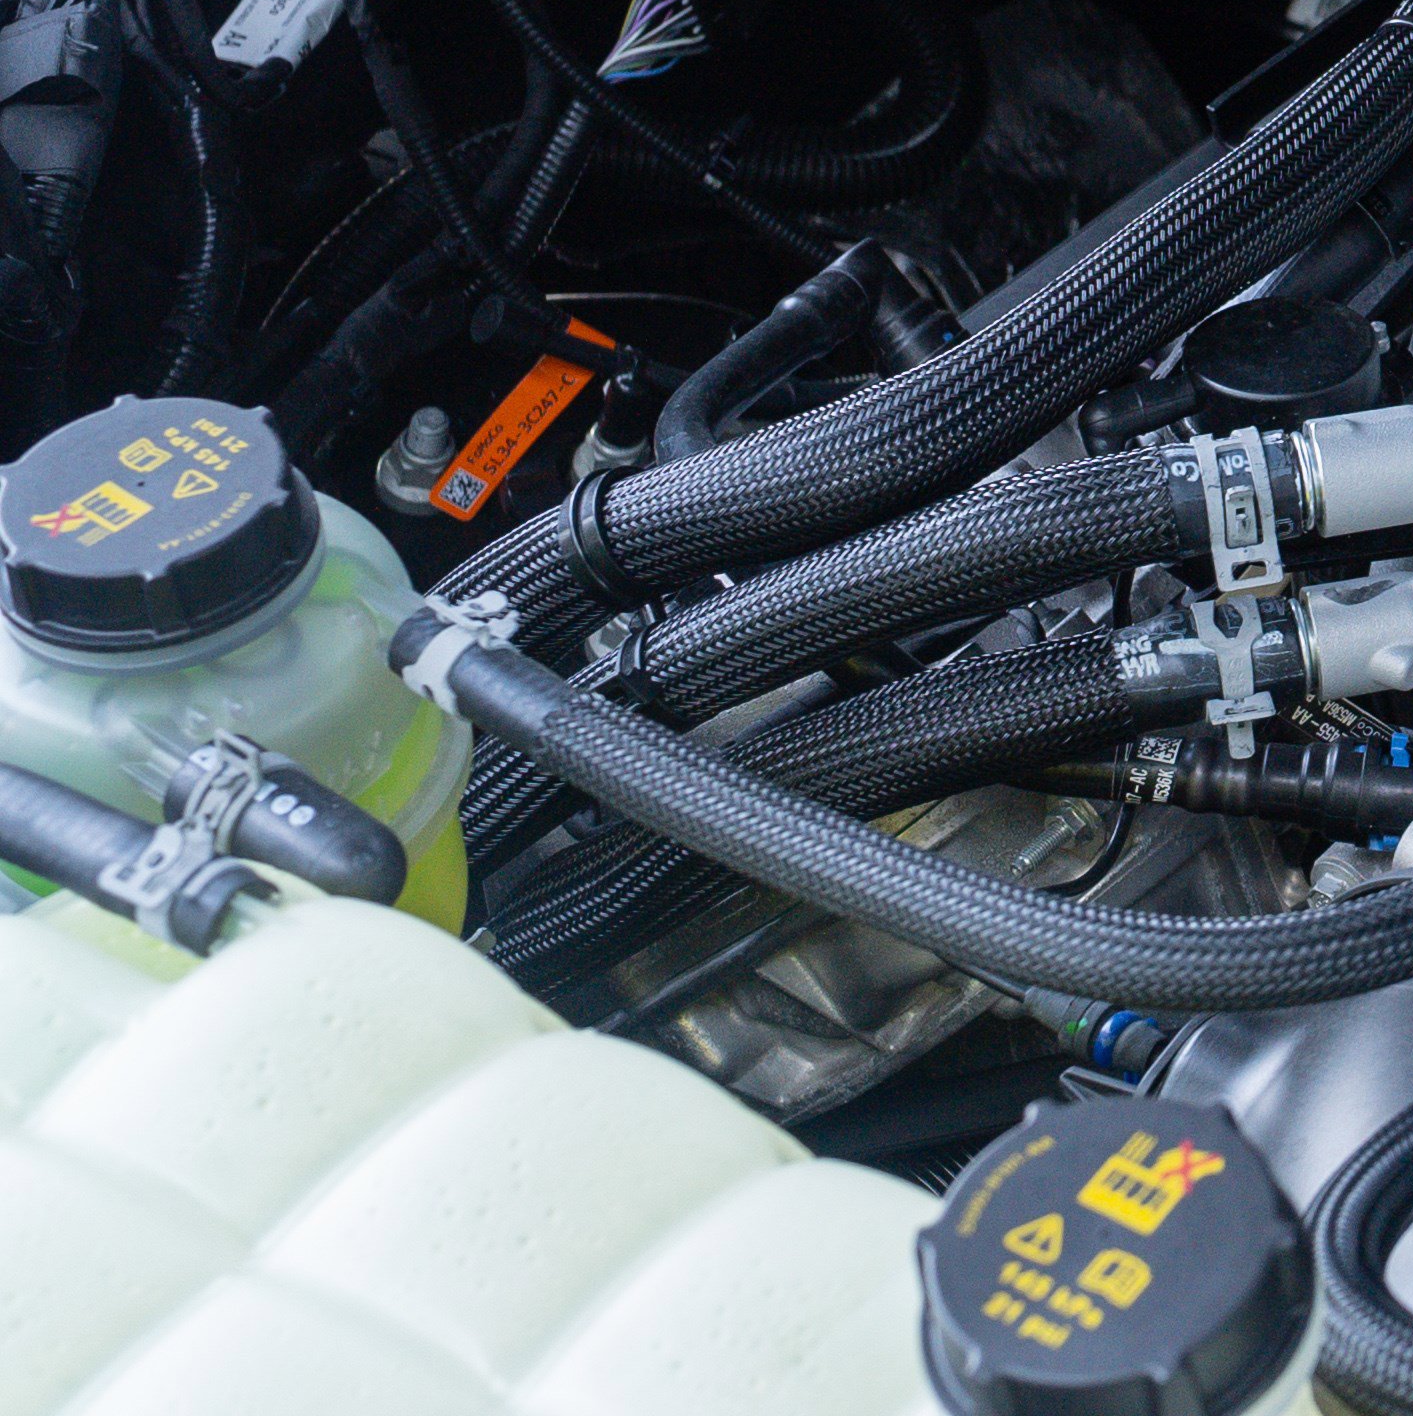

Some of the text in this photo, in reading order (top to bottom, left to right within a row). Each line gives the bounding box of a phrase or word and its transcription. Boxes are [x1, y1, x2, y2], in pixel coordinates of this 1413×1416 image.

[163, 427, 231, 472] 145 kPa
[190, 418, 249, 454] 21 psi
